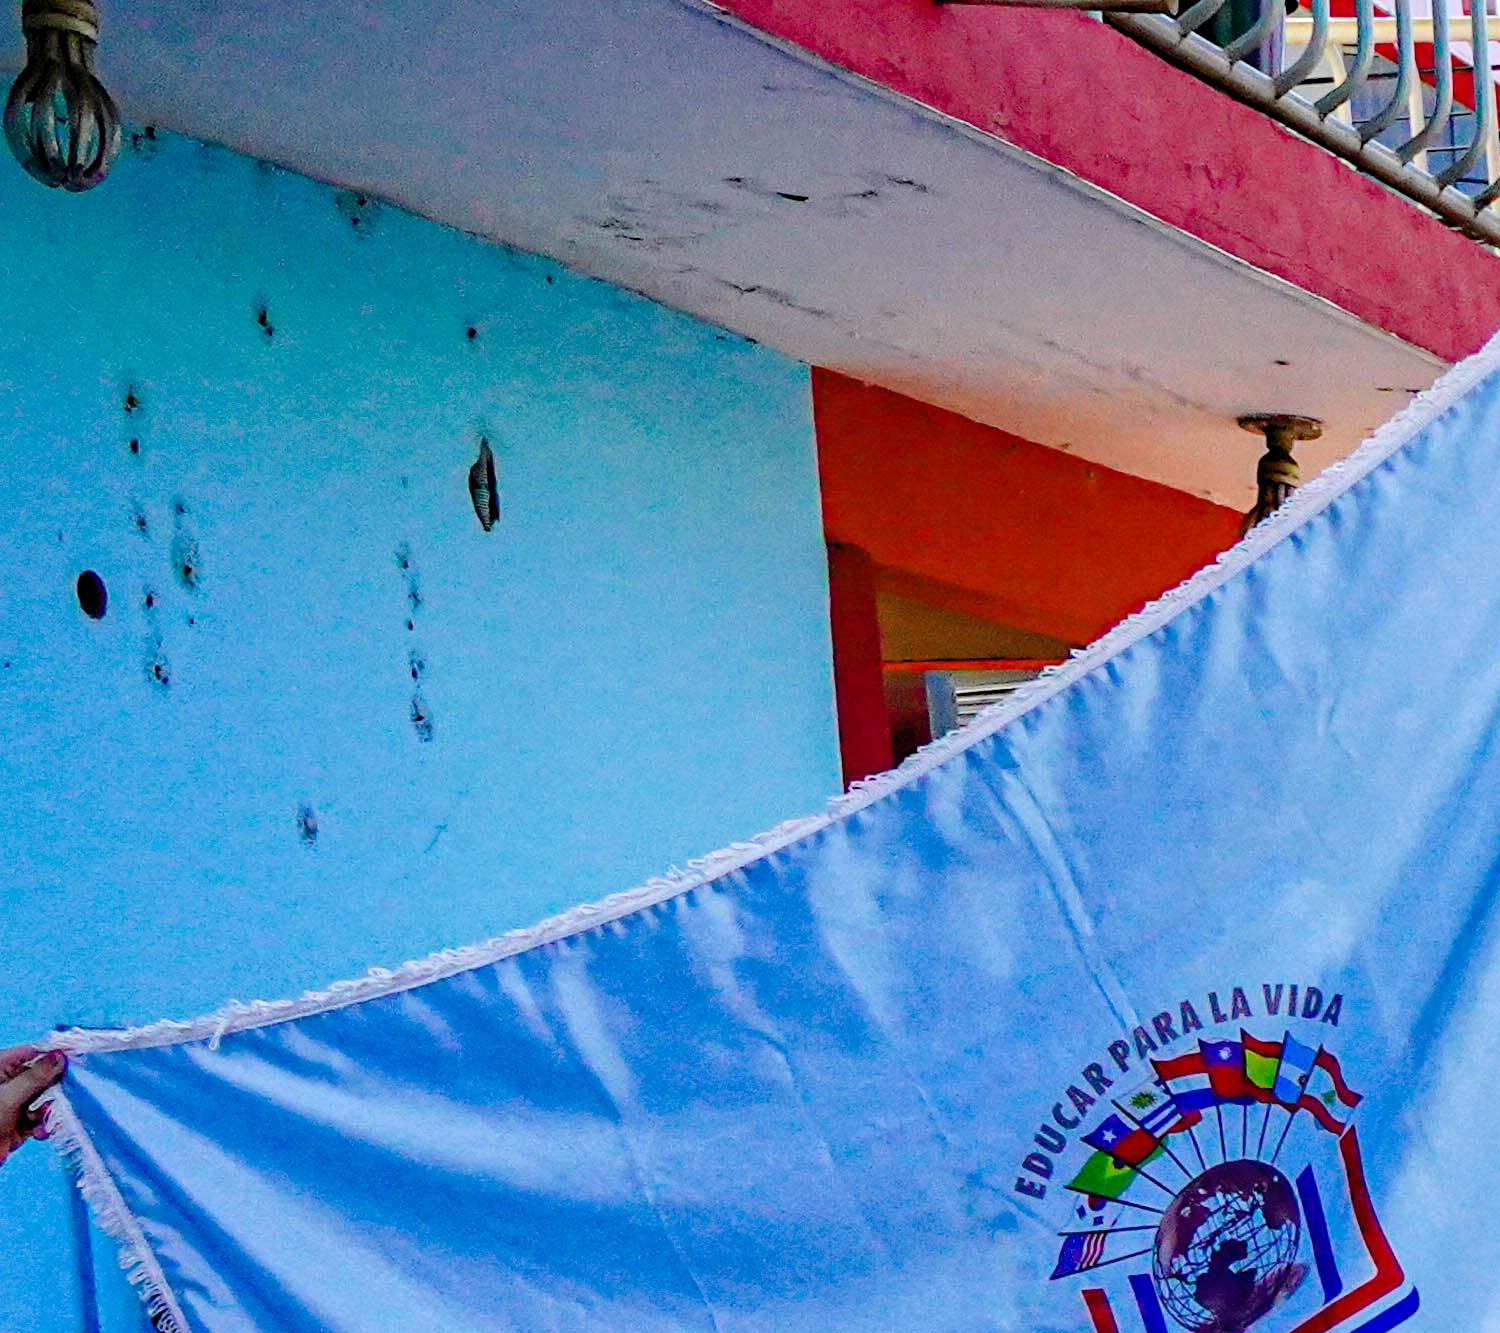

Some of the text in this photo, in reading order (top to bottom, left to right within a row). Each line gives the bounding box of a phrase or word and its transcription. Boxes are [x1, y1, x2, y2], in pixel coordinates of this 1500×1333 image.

[1015, 984, 1344, 1200] EDUCAR PARA LA VIDA
